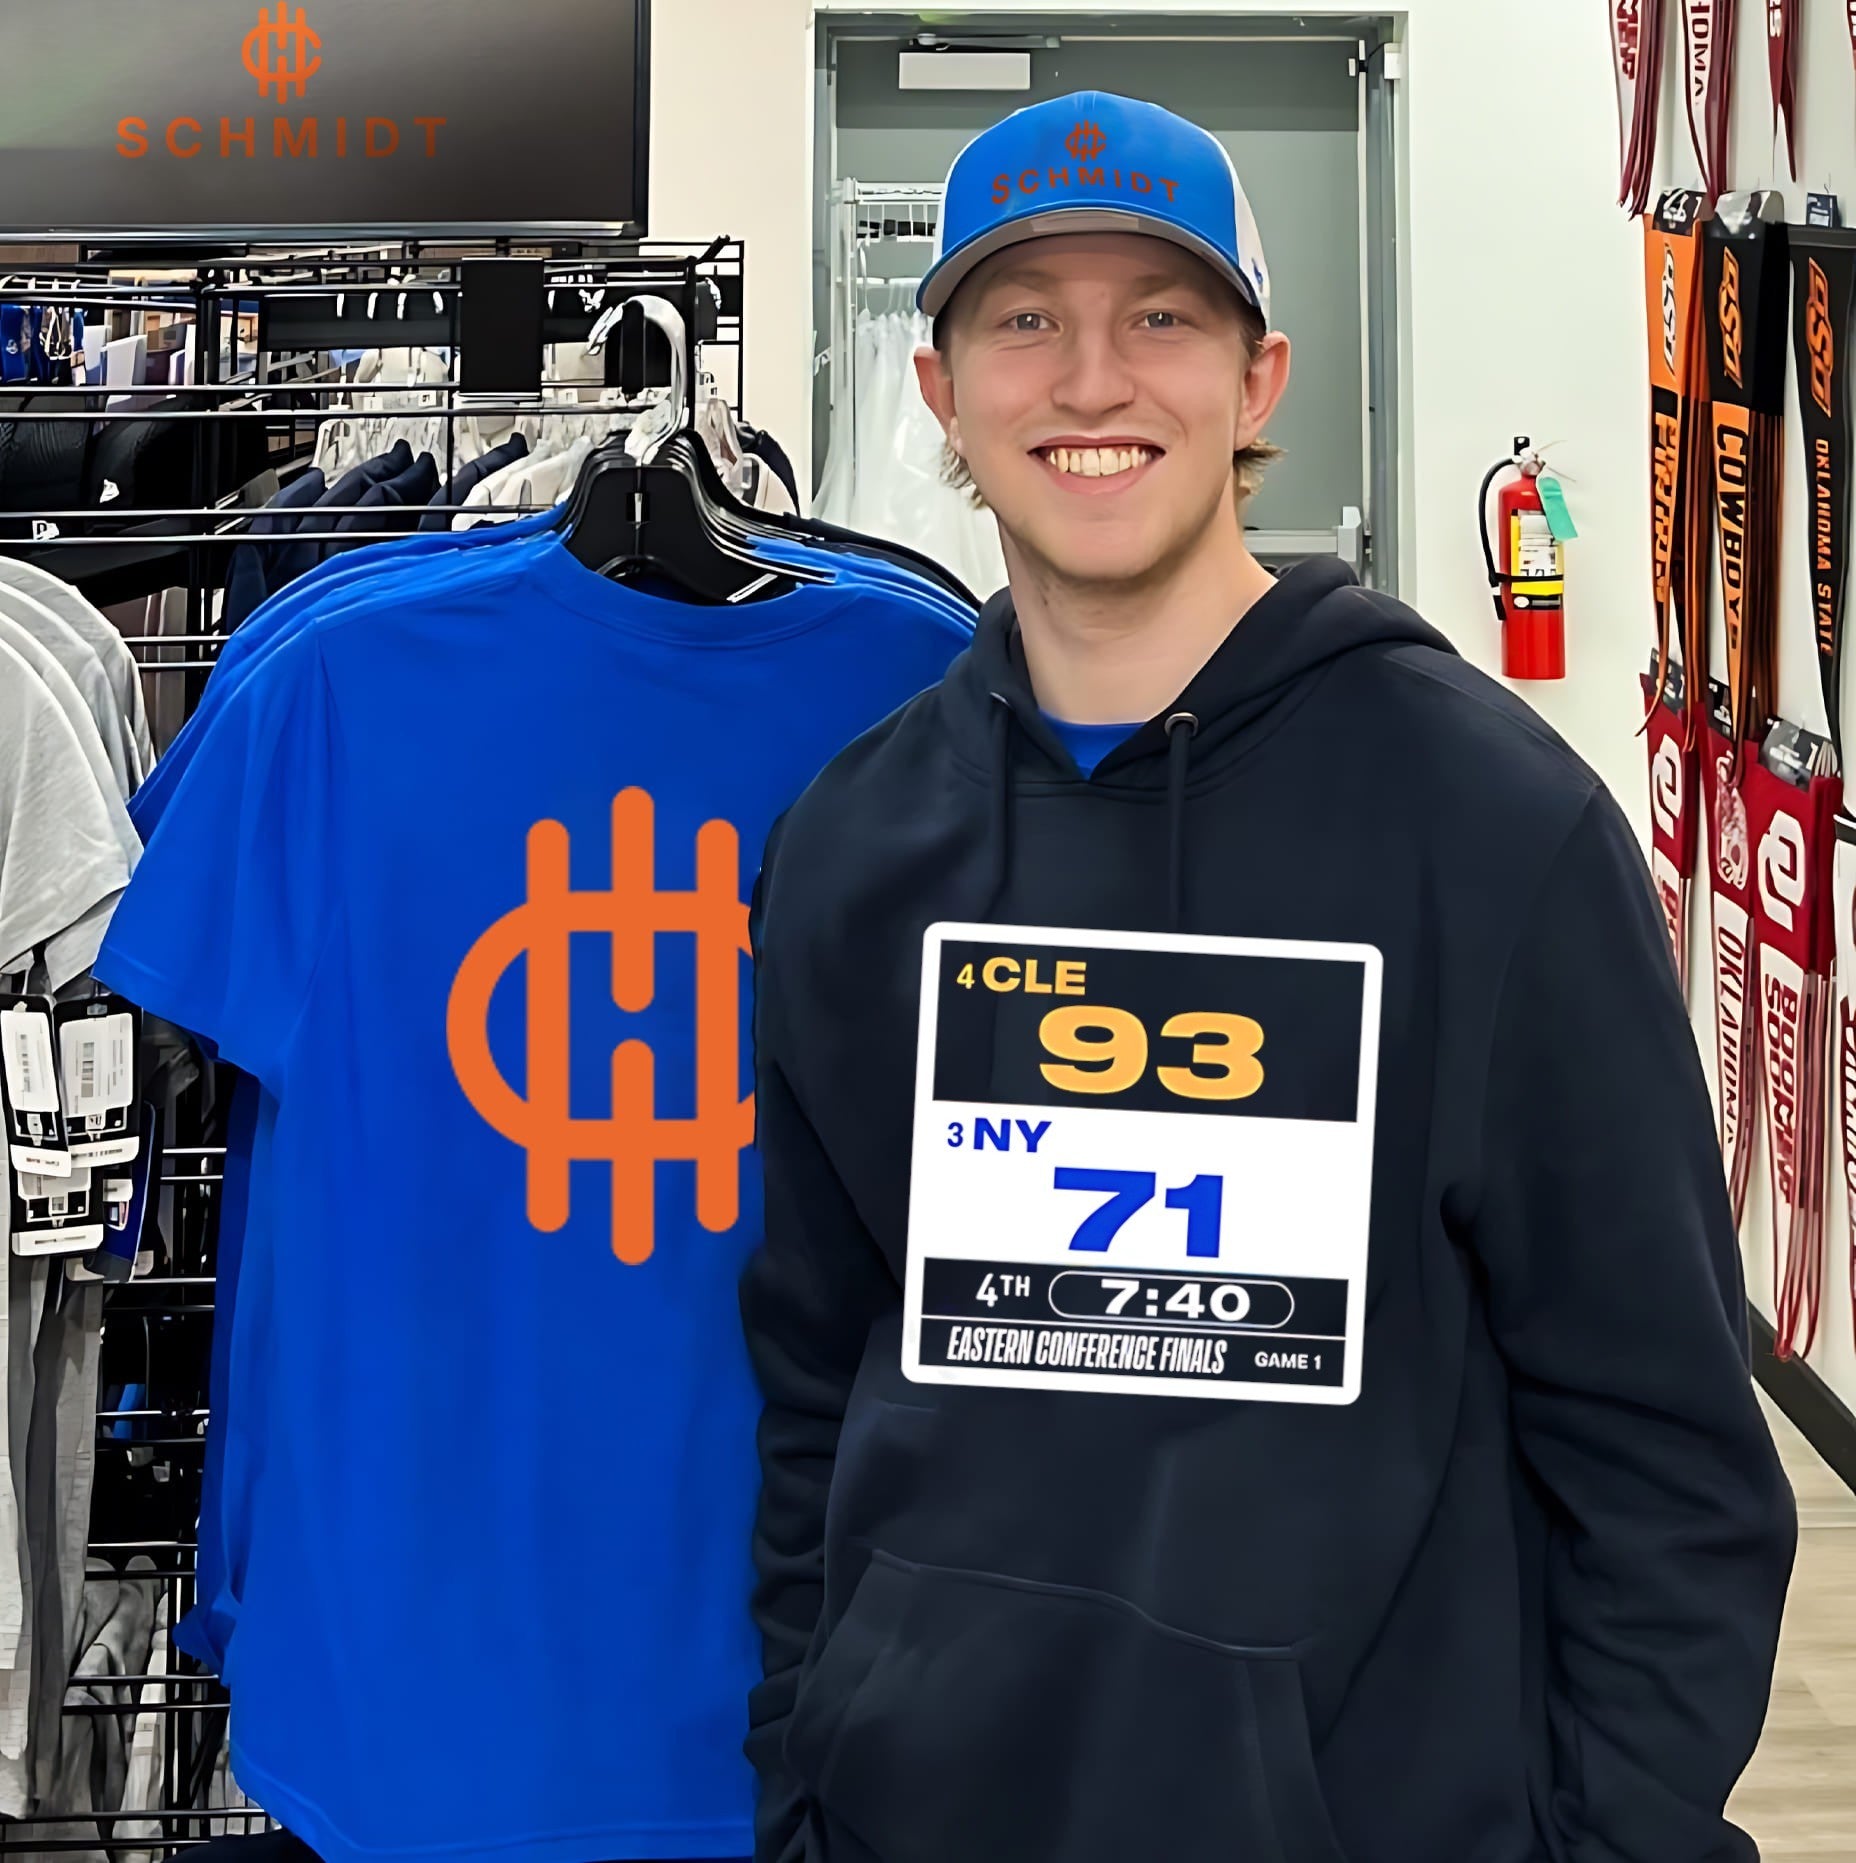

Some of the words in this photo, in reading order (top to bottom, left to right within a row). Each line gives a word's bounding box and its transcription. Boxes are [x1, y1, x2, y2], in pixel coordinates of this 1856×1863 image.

[116, 116, 447, 159] SCHMIDT
[992, 167, 1179, 204] SCHMIDT
[1815, 438, 1832, 571] OKLAHOMA
[957, 963, 975, 988] 4
[982, 957, 1087, 996] CLE
[1038, 1005, 1265, 1100] 93
[1718, 925, 1745, 1144] OKLAHOMA
[947, 1123, 964, 1148] 3
[973, 1117, 1052, 1153] NY
[1053, 1166, 1224, 1259] 71
[975, 1273, 1031, 1307] 4TH
[1100, 1278, 1251, 1322] 7:40
[946, 1326, 1032, 1365] EASTERN
[1035, 1330, 1160, 1372] CONFERENCE
[1159, 1336, 1229, 1374] FINALS
[1254, 1351, 1310, 1370] GAME
[1313, 1354, 1322, 1371] 1
